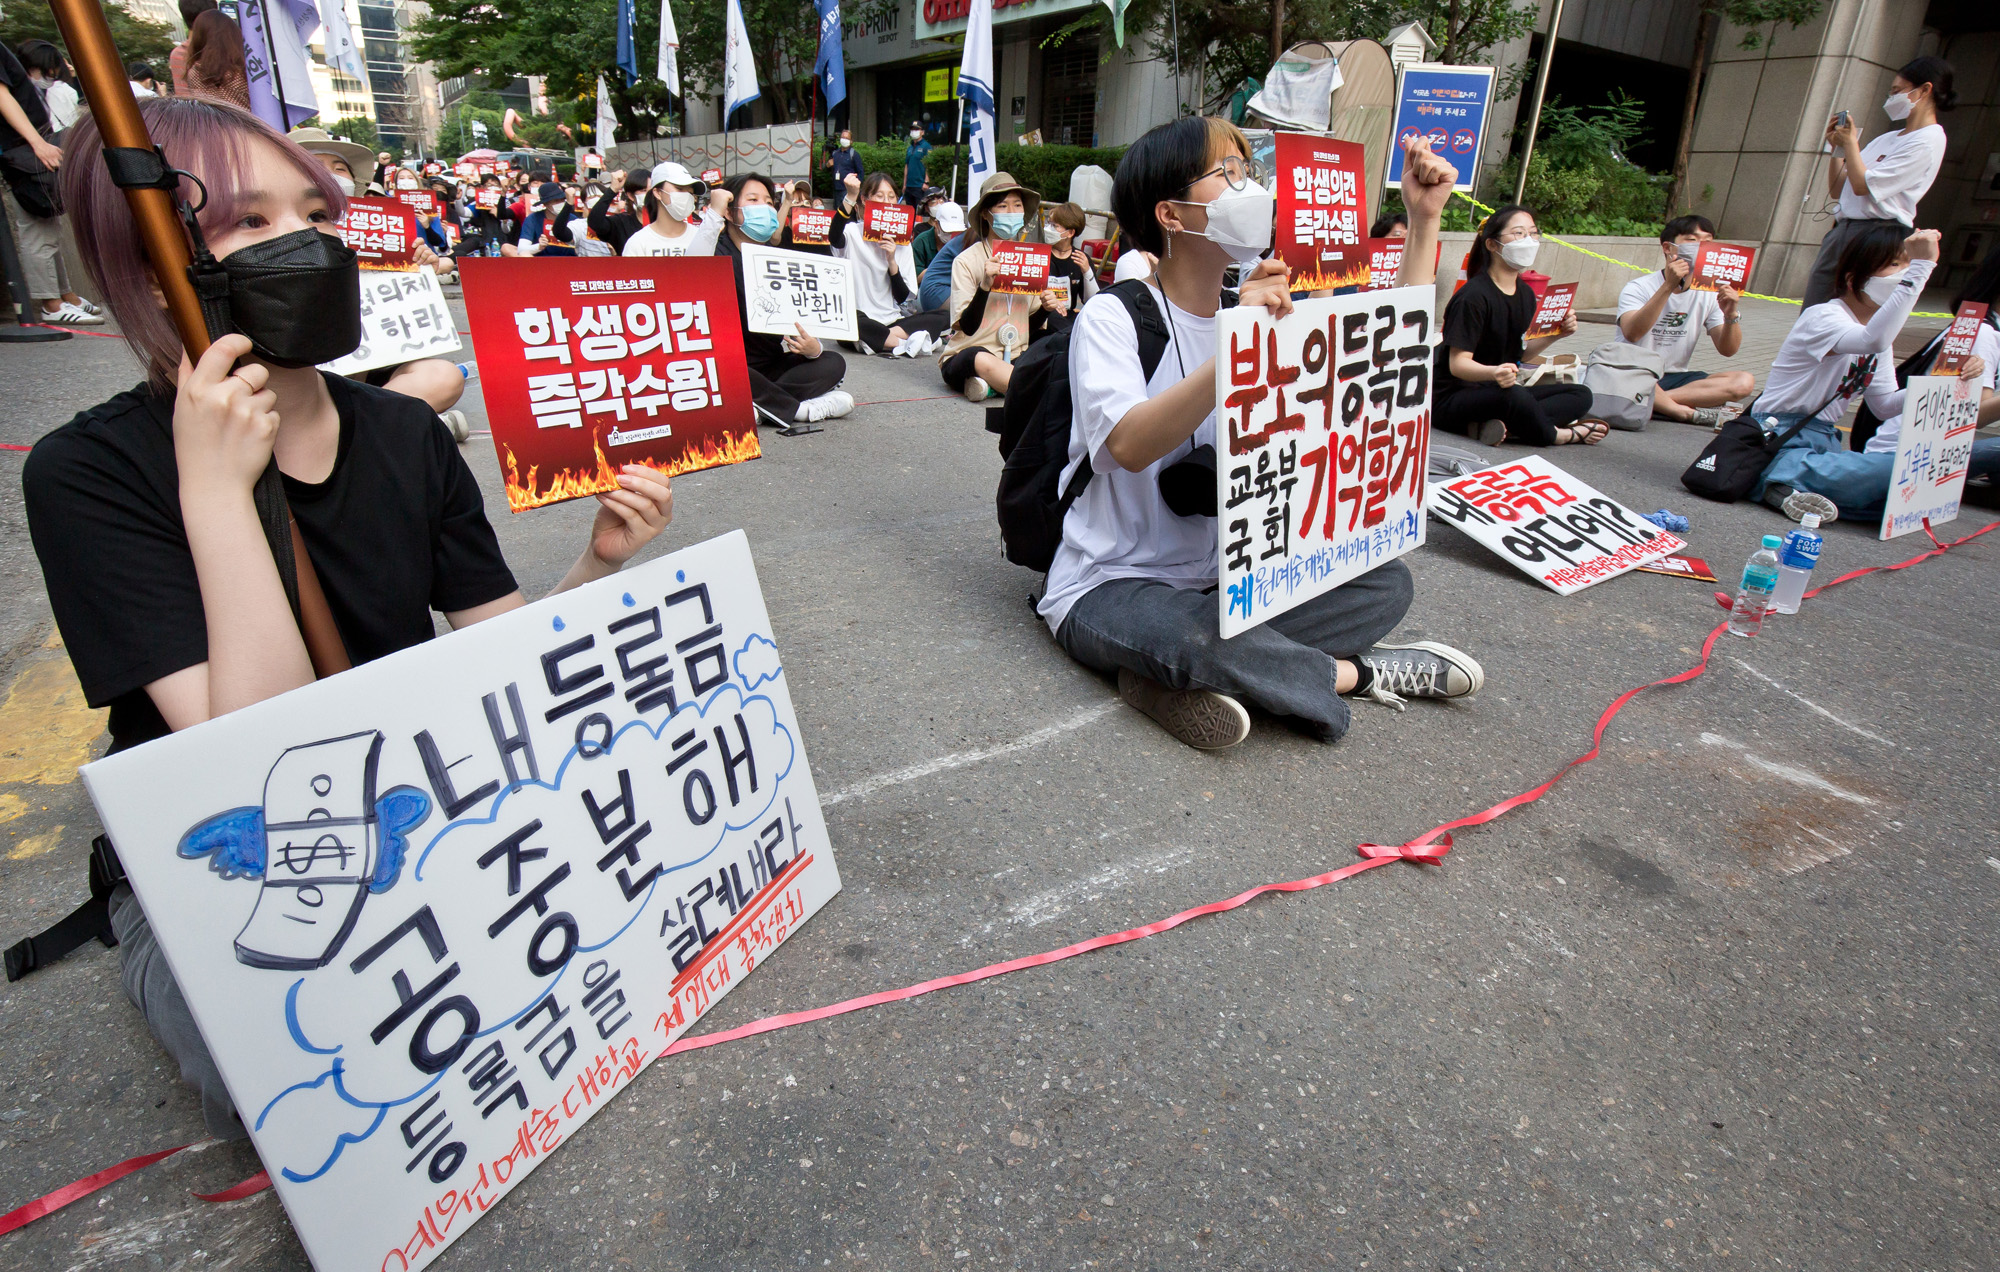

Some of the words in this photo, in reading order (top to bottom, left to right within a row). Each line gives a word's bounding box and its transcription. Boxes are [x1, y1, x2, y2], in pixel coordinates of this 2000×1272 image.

[878, 32, 899, 44] DEPOT
[1444, 107, 1467, 116] 주세요
[1293, 166, 1357, 206] 학생의견
[870, 220, 908, 235] 즉각수용!
[872, 209, 909, 224] 학생의견
[1295, 209, 1359, 246] 즉각수용!
[1000, 264, 1020, 277] 즉각
[1025, 253, 1049, 266] 등록금
[1371, 251, 1403, 270] 학생의
[1705, 251, 1748, 269] 학생의견
[570, 280, 588, 292] 전국
[589, 280, 614, 291] 대학생
[615, 279, 638, 291] 분노의
[639, 278, 655, 290] 집회
[763, 260, 819, 292] 등록금
[1701, 264, 1744, 283] 즉각수용!
[791, 291, 844, 324] 반환!!
[513, 300, 713, 365] 학생의견
[528, 357, 723, 430] 즉각수용!
[1226, 439, 1299, 510] 교육부
[1299, 408, 1430, 542] 기억할게
[1695, 462, 1717, 472] adidas
[1225, 502, 1291, 571] 국회
[1501, 497, 1656, 567] 어디에?
[1797, 538, 1821, 548] POCA
[1795, 544, 1820, 553] SWEA
[414, 683, 540, 820] 내
[540, 581, 730, 760] 등록금
[737, 888, 804, 973] 총학생회
[400, 959, 633, 1184] 등록금을
[660, 796, 803, 973] 살려내라
